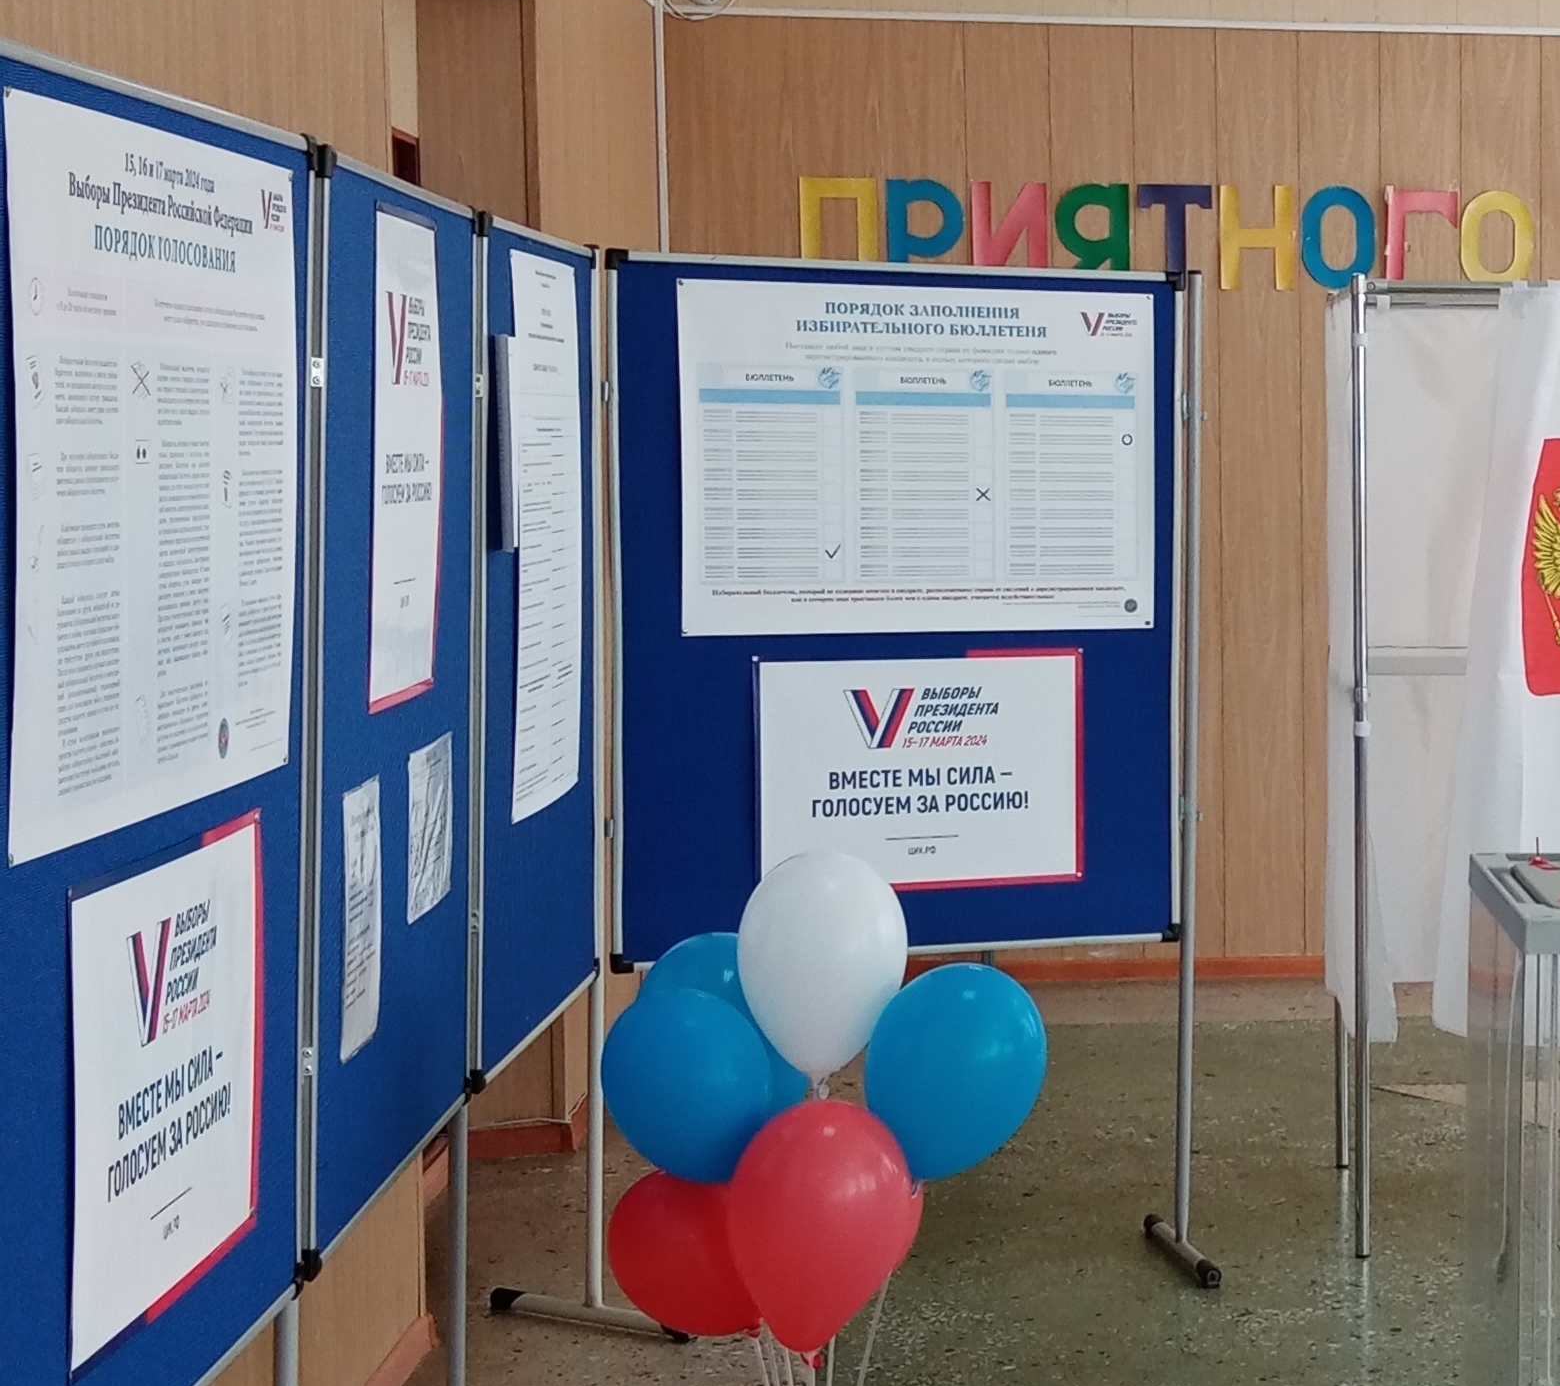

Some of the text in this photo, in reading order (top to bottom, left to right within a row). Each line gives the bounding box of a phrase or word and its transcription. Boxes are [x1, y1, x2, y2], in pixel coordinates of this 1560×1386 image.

[138, 155, 148, 178] 16
[68, 172, 110, 210] Выборы
[113, 181, 166, 216] Президента
[167, 194, 213, 226] Российской
[213, 205, 253, 238] Федерации
[798, 177, 1535, 291] ПРИЯТНОГО
[94, 224, 236, 274] ПОРЯДОК ГОЛОСОВАНИЯ
[825, 301, 1020, 319] ПОРЯДОК ЗАПОЛНЕНИЯ
[796, 319, 1047, 339] ИЗБИРАТЕЛЬНОГО БЮЛЛЕТЕНЯ
[921, 686, 982, 701] ВЫБОРЫ
[914, 702, 999, 718] ПРЕЗИДЕНТА
[907, 720, 963, 734] РОССИИ
[930, 735, 963, 748] МАРТА
[964, 734, 988, 747] 2024
[828, 769, 902, 791] ВМЕСТЕ
[908, 767, 941, 787] МЫ
[947, 766, 996, 786] СИЛА
[811, 790, 1029, 819] ГОЛОСУЕМ ЗА РОССИЮ!
[174, 898, 211, 938] ВЫБОРЫ
[169, 925, 218, 972] ПРЕЗИДЕНТА
[165, 966, 200, 1006] РОССИИ
[118, 1077, 163, 1140] ВМЕСТЕ
[165, 1064, 185, 1109] МЫ
[187, 1045, 214, 1093] СИЛА
[108, 1081, 231, 1203] ГОЛОСУЕМ ЗА РОССИЮ!
